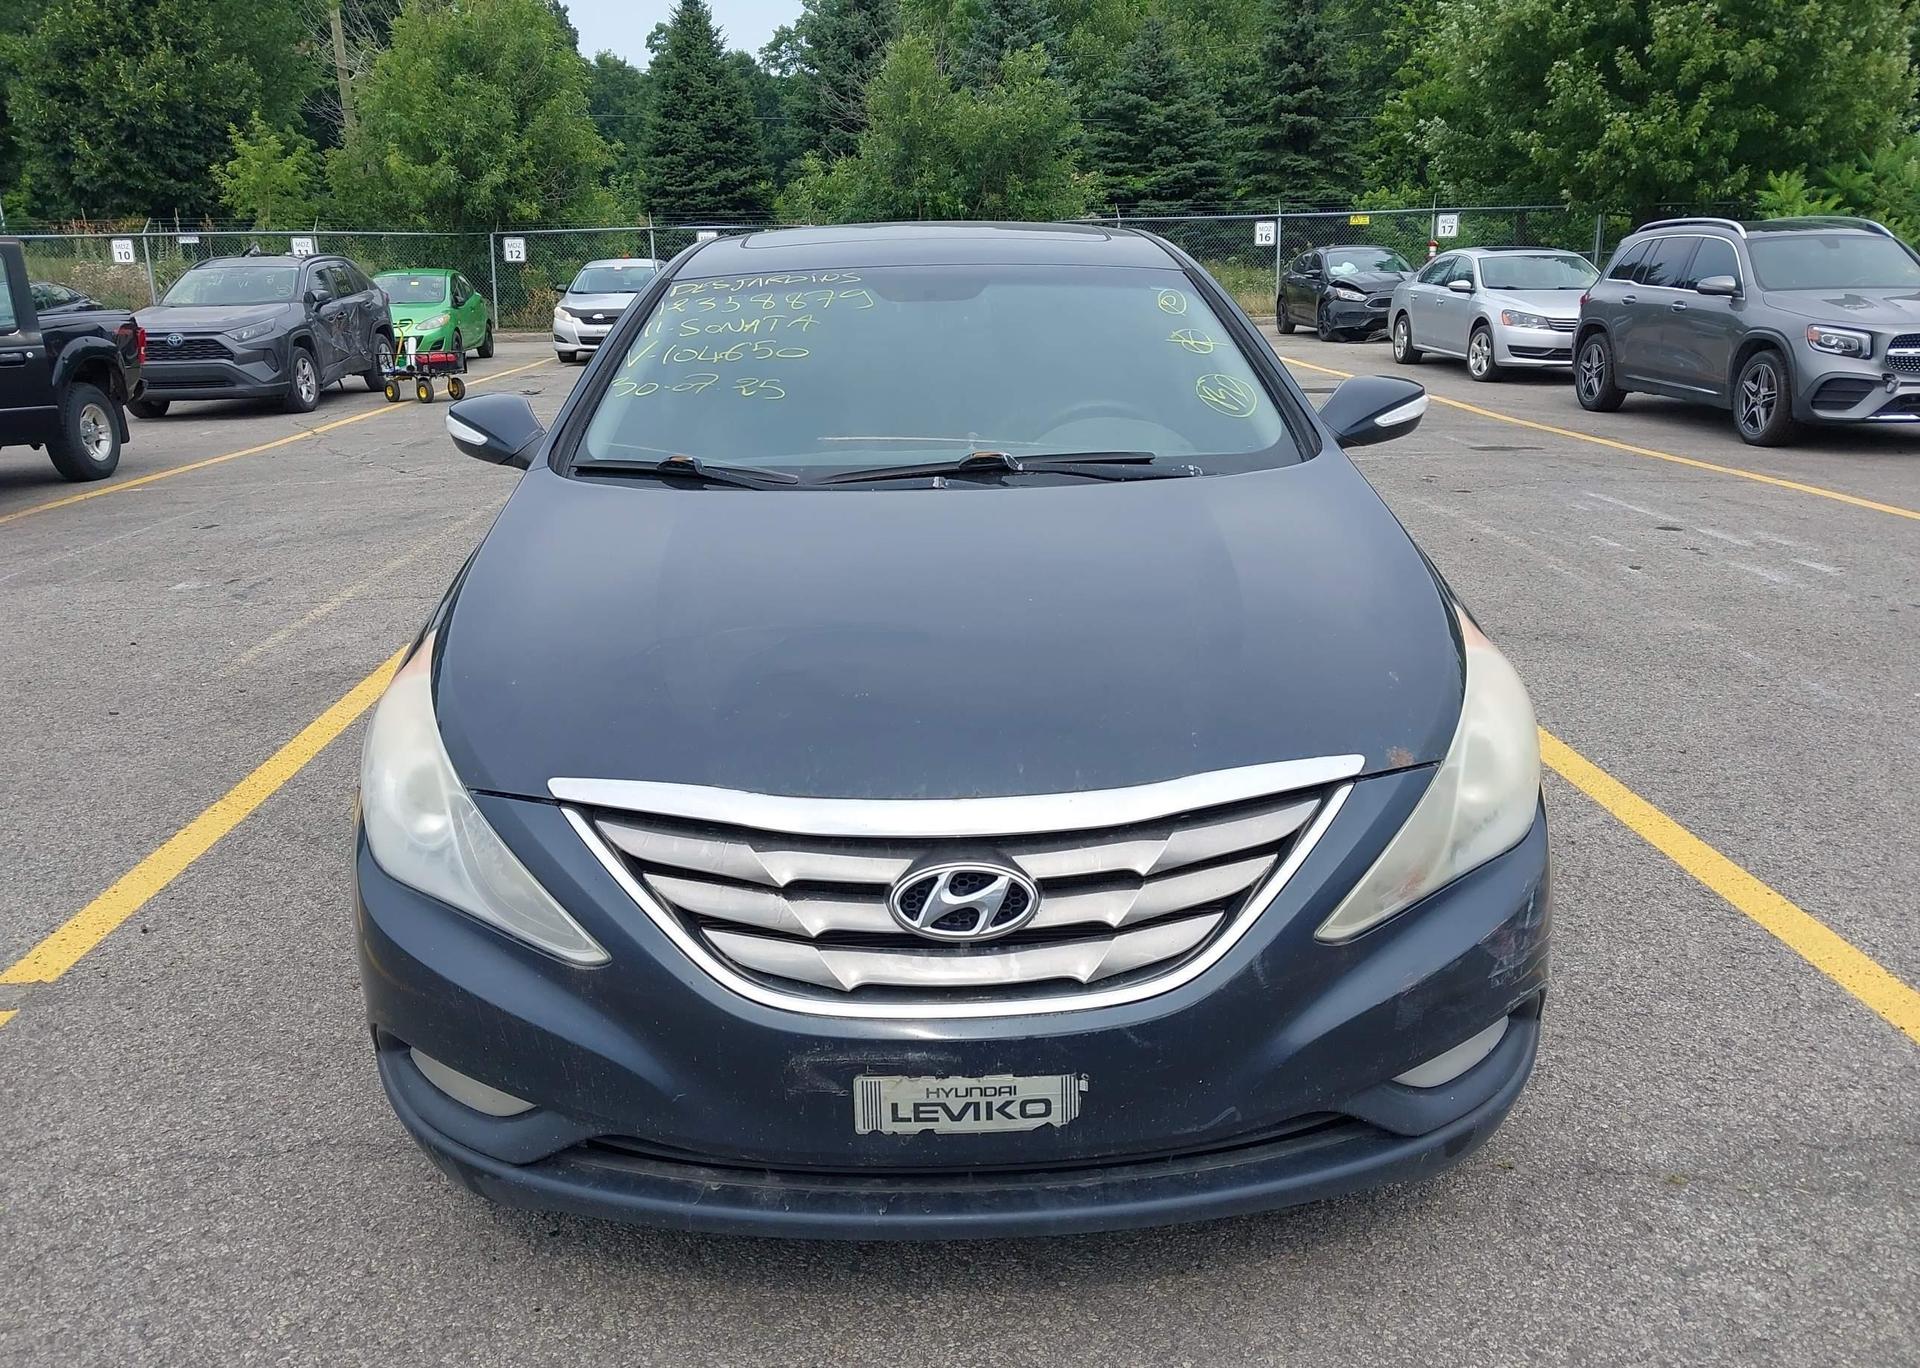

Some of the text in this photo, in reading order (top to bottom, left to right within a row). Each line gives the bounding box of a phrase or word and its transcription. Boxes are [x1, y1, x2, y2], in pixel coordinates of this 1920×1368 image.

[1441, 225, 1454, 234] 17
[1259, 233, 1271, 242] 16
[117, 251, 131, 260] 10
[508, 250, 521, 259] 12
[669, 272, 862, 297] DESJARDINS
[926, 1085, 1017, 1099] HYUNDAI
[890, 1098, 1053, 1123] LEVIKO
